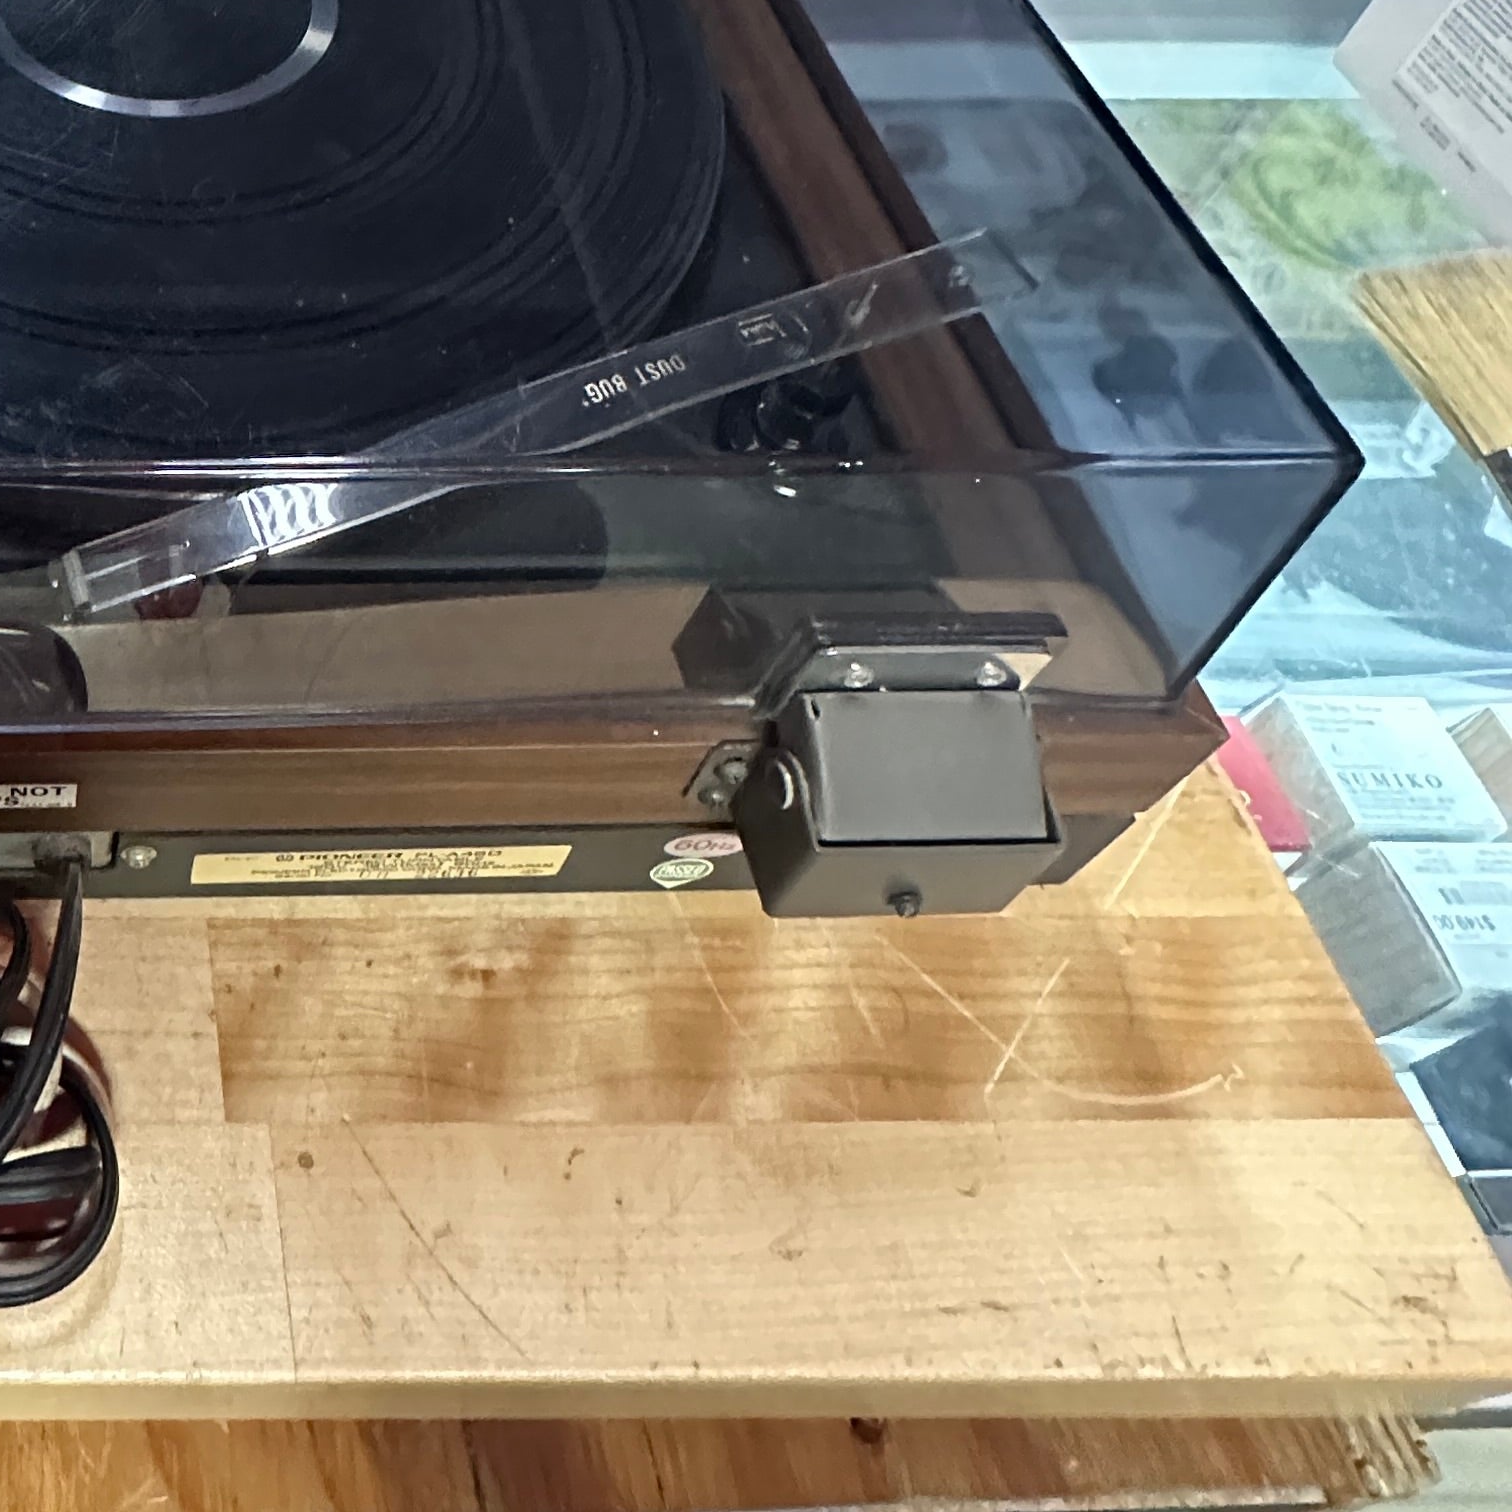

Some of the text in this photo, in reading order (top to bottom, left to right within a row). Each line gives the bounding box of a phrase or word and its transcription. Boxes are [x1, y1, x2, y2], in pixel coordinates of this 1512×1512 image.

[634, 354, 687, 387] DUST
[1336, 772, 1444, 790] SUMIKO
[10, 785, 67, 797] NOT
[299, 849, 405, 861] PIONEER
